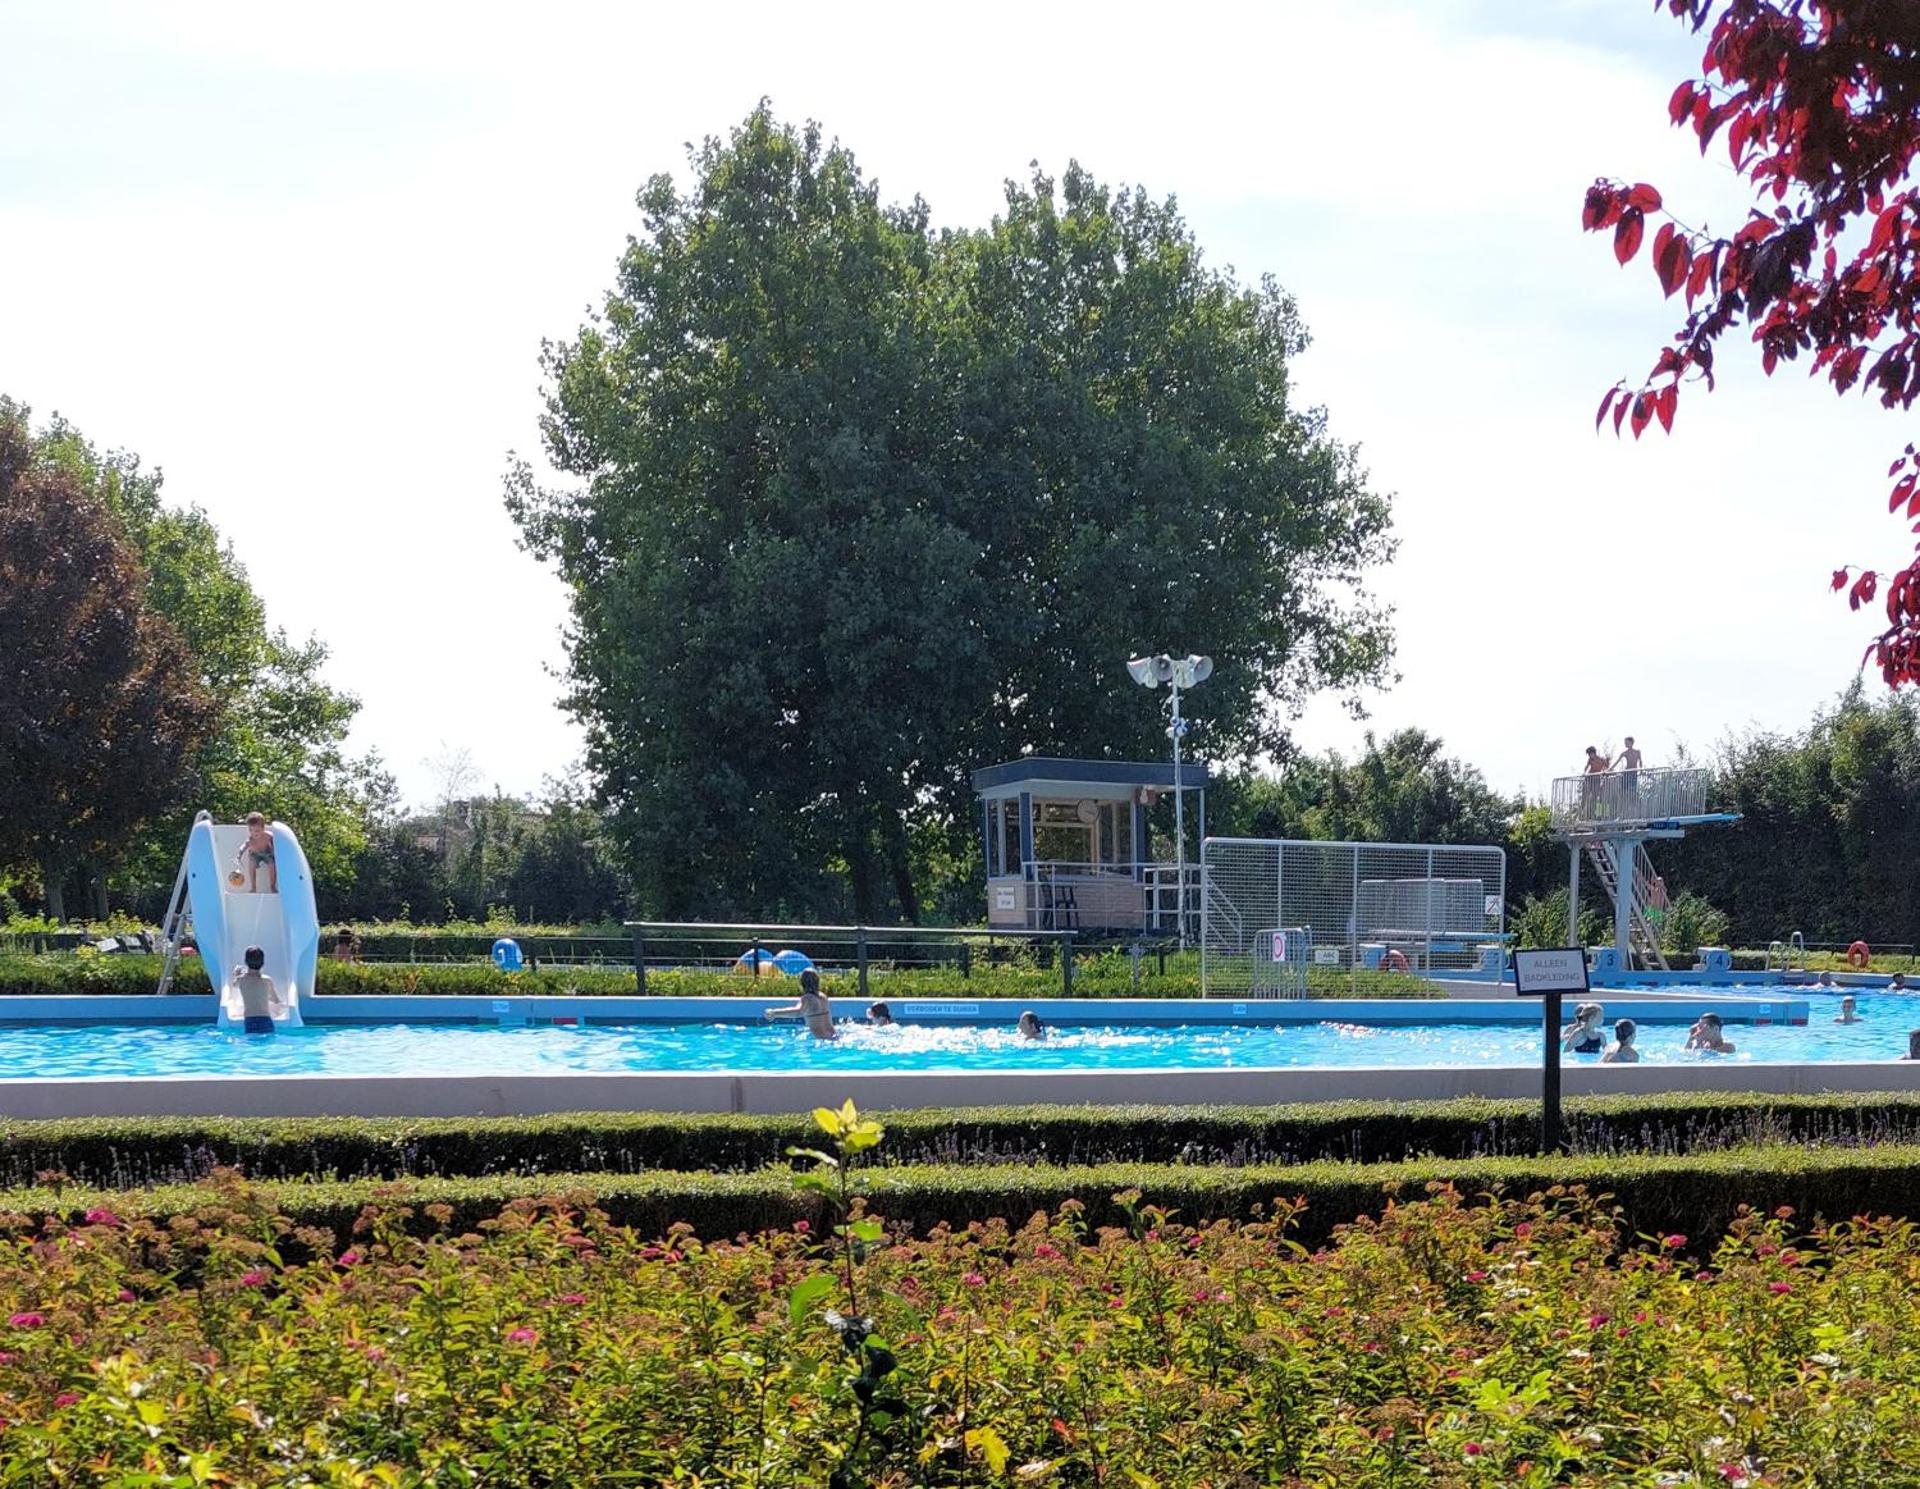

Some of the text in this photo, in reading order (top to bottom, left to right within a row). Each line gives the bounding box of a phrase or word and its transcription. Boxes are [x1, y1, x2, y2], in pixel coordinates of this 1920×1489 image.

[1534, 959, 1568, 968] ALLEEN
[1607, 953, 1614, 966] 3
[1716, 954, 1723, 965] 4
[1524, 972, 1580, 982] BADKLEDING
